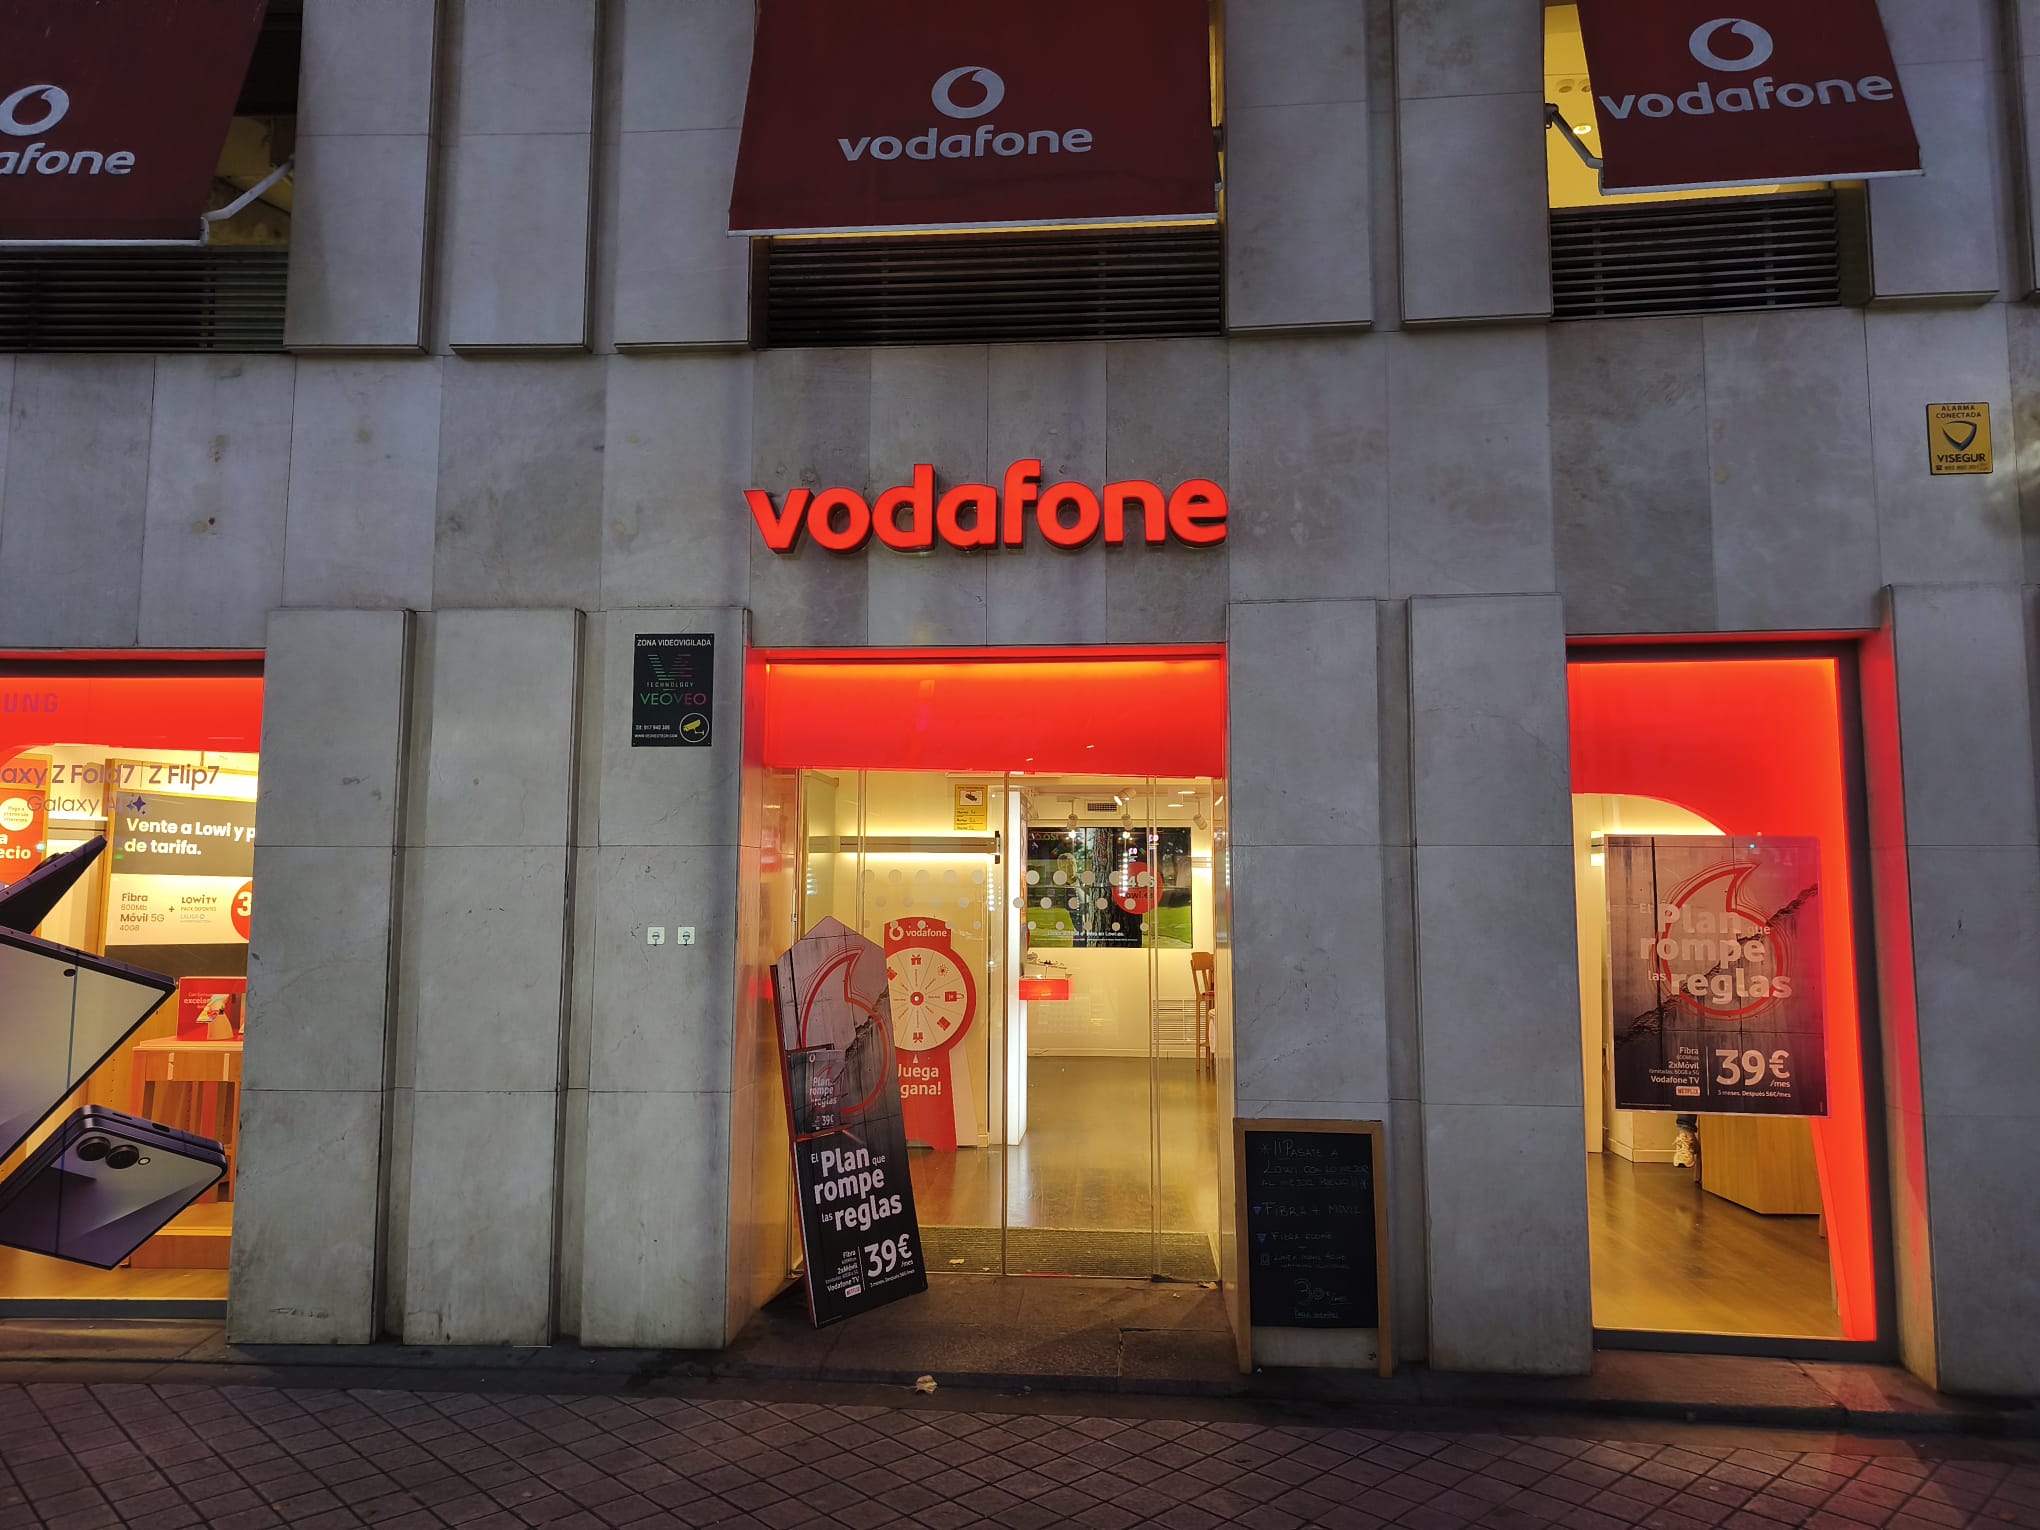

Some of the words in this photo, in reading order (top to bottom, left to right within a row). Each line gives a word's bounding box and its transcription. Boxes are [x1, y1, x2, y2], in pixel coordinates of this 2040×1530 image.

[1599, 75, 1894, 120] vodafone
[837, 124, 1093, 161] vodafone
[1935, 411, 1982, 419] CONECTADA
[1936, 453, 1986, 463] VISEGUR
[744, 458, 1229, 554] vodafone
[658, 639, 711, 647] VIDEOVIGILADA
[640, 693, 707, 705] VEOVEO
[52, 765, 65, 784] Z
[71, 763, 134, 784] Fold7
[149, 765, 162, 784] Z
[168, 763, 220, 791] Flip7
[27, 795, 99, 817] Galaxy
[126, 817, 178, 834] Vente
[180, 823, 192, 835] a
[195, 822, 231, 837] Lowi
[234, 827, 244, 842] y
[124, 838, 147, 852] de
[150, 839, 202, 855] tarifa.
[121, 892, 148, 902] Fibra
[120, 911, 148, 922] Móvil
[150, 913, 165, 922] 5G
[1658, 902, 1741, 935] Plan
[905, 928, 947, 937] vodafone
[1640, 937, 1766, 970] rompe
[1648, 970, 1667, 982] las
[1671, 968, 1793, 1005] reglas
[1680, 1047, 1699, 1055] Fibra
[898, 1063, 939, 1081] Juega
[1668, 1061, 1699, 1070] 2xMóvil
[1716, 1049, 1790, 1086] 39€
[1651, 1076, 1688, 1084] Vodafone
[1769, 1080, 1791, 1088] /mes
[900, 1081, 942, 1098] gana!
[811, 1152, 820, 1164] El
[821, 1147, 870, 1178] Plan
[872, 1155, 886, 1167] que
[814, 1168, 886, 1205] rompe
[821, 1212, 834, 1223] las
[834, 1194, 903, 1232] reglas
[842, 1250, 857, 1259] Fibra
[864, 1233, 912, 1278] 39€
[827, 1279, 852, 1293] Vodafone
[852, 1275, 860, 1285] TV
